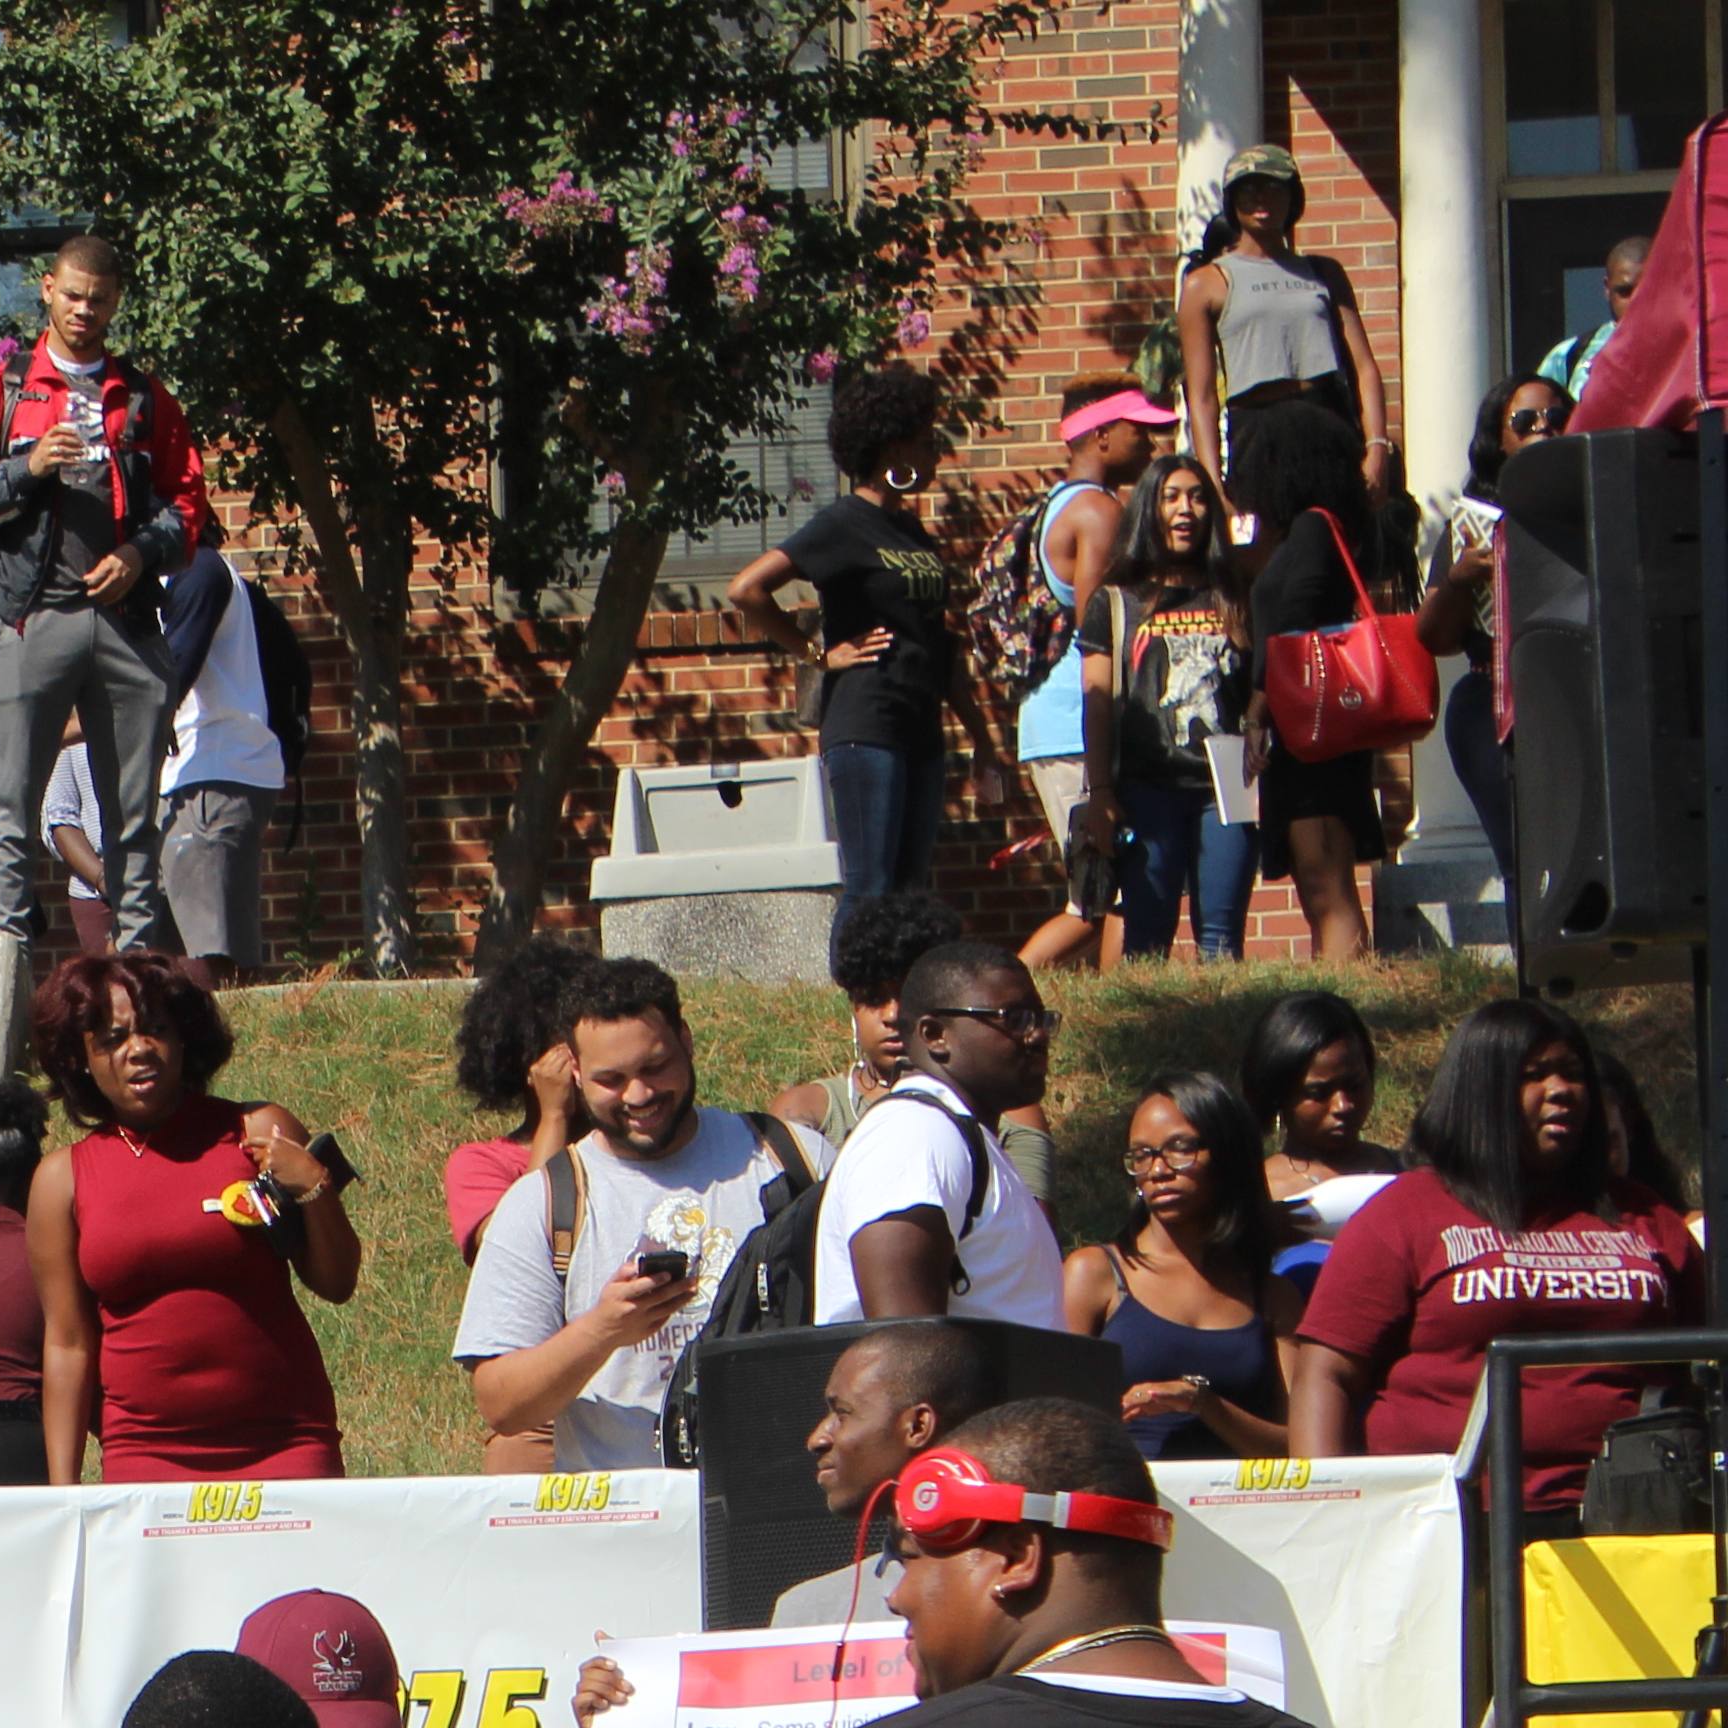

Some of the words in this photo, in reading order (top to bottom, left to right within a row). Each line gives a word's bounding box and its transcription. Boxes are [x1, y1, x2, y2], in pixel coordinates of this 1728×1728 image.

[876, 547, 944, 571] NCCU
[1441, 1224, 1500, 1268] NORTH
[1515, 1254, 1612, 1267] EAGLES
[1453, 1266, 1669, 1308] UNIVERSITY
[187, 1482, 263, 1522] K97.5
[534, 1472, 611, 1512] K97.5
[793, 1655, 866, 1683] Leel
